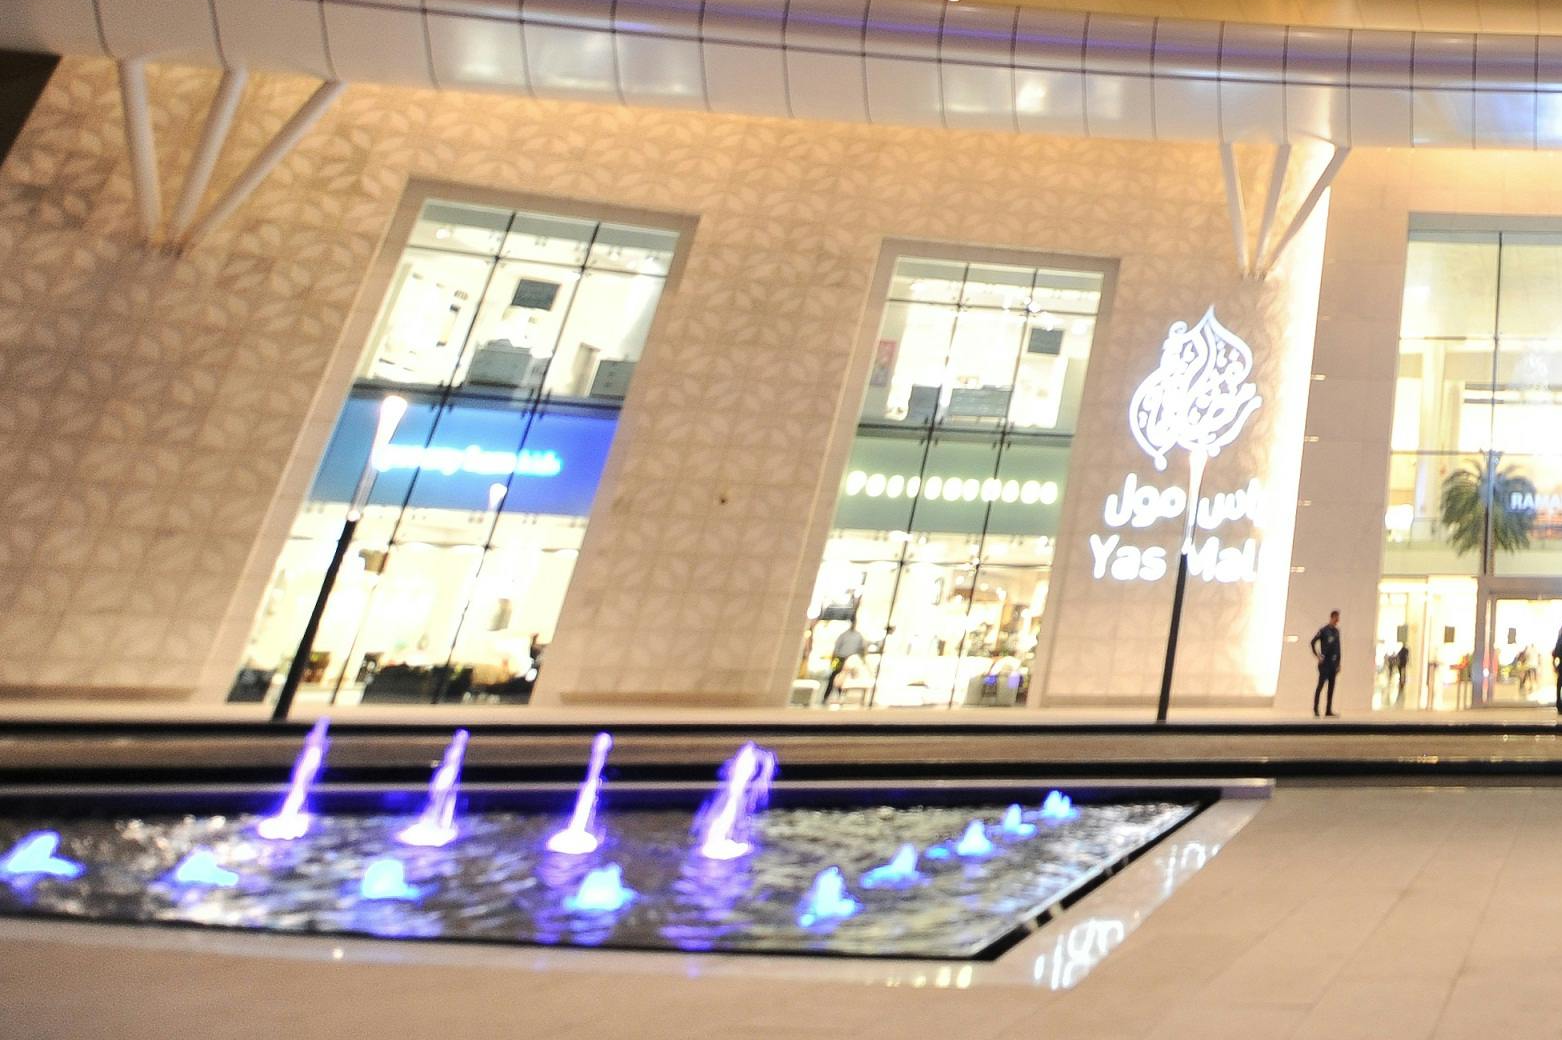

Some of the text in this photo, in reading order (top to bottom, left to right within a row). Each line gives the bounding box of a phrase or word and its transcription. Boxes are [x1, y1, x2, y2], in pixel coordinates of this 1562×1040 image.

[1104, 473, 1186, 527] مول
[1197, 478, 1273, 529] اس
[1089, 534, 1167, 581] Yas
